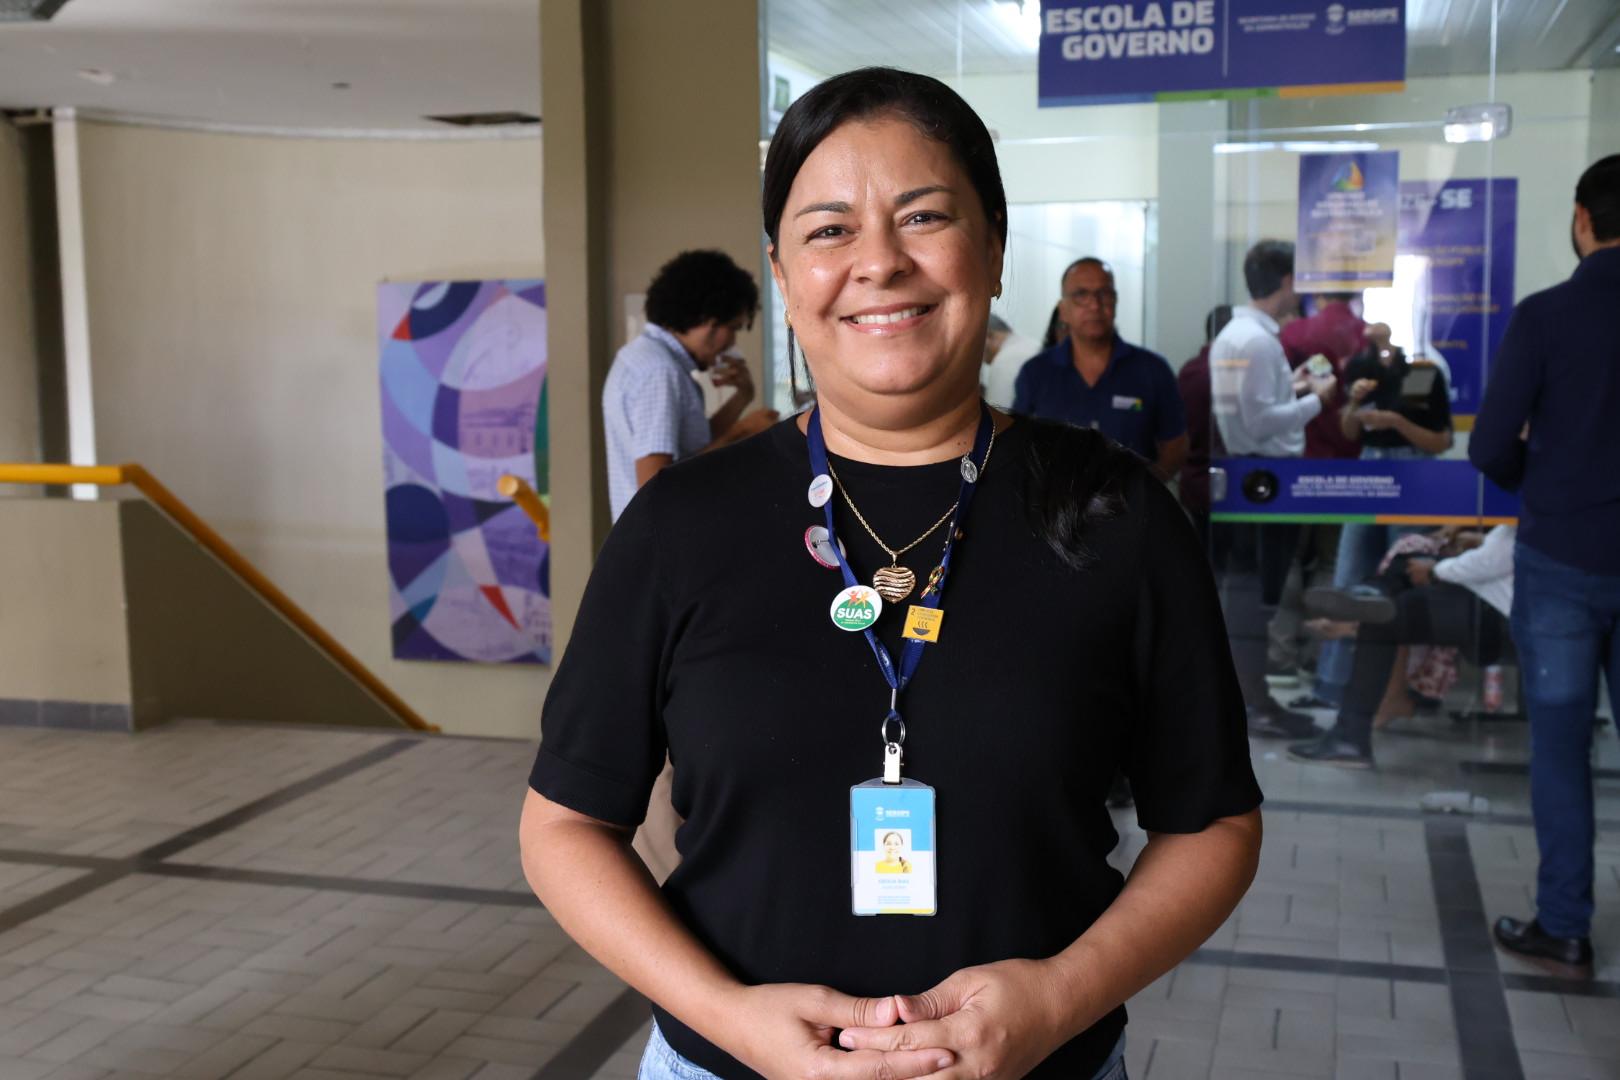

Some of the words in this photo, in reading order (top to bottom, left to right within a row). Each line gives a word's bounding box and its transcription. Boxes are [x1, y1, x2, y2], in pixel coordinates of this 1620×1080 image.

[1046, 3, 1166, 34] ESCOLA
[1172, 0, 1215, 27] DE
[1062, 28, 1215, 61] GOVERNO
[837, 607, 873, 620] SUAS
